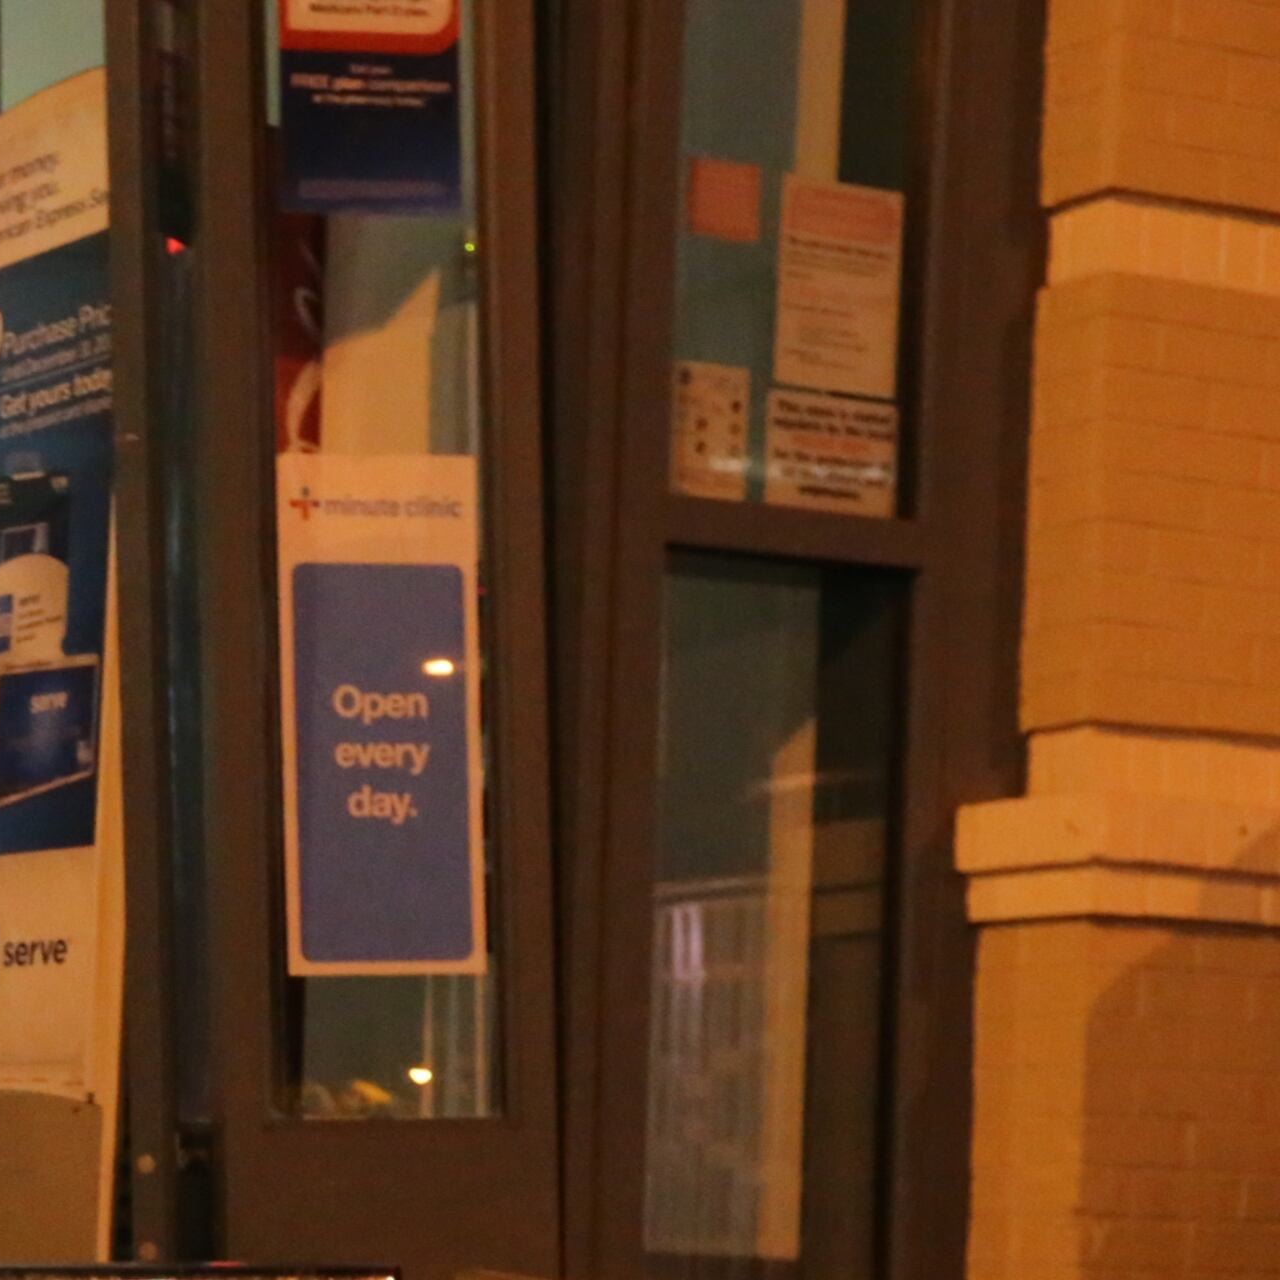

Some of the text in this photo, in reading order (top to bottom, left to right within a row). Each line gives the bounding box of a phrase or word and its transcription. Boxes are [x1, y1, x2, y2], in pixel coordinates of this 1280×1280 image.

[332, 684, 429, 726] Open
[334, 742, 431, 776] every
[347, 783, 418, 825] day.
[3, 938, 69, 967] serve
